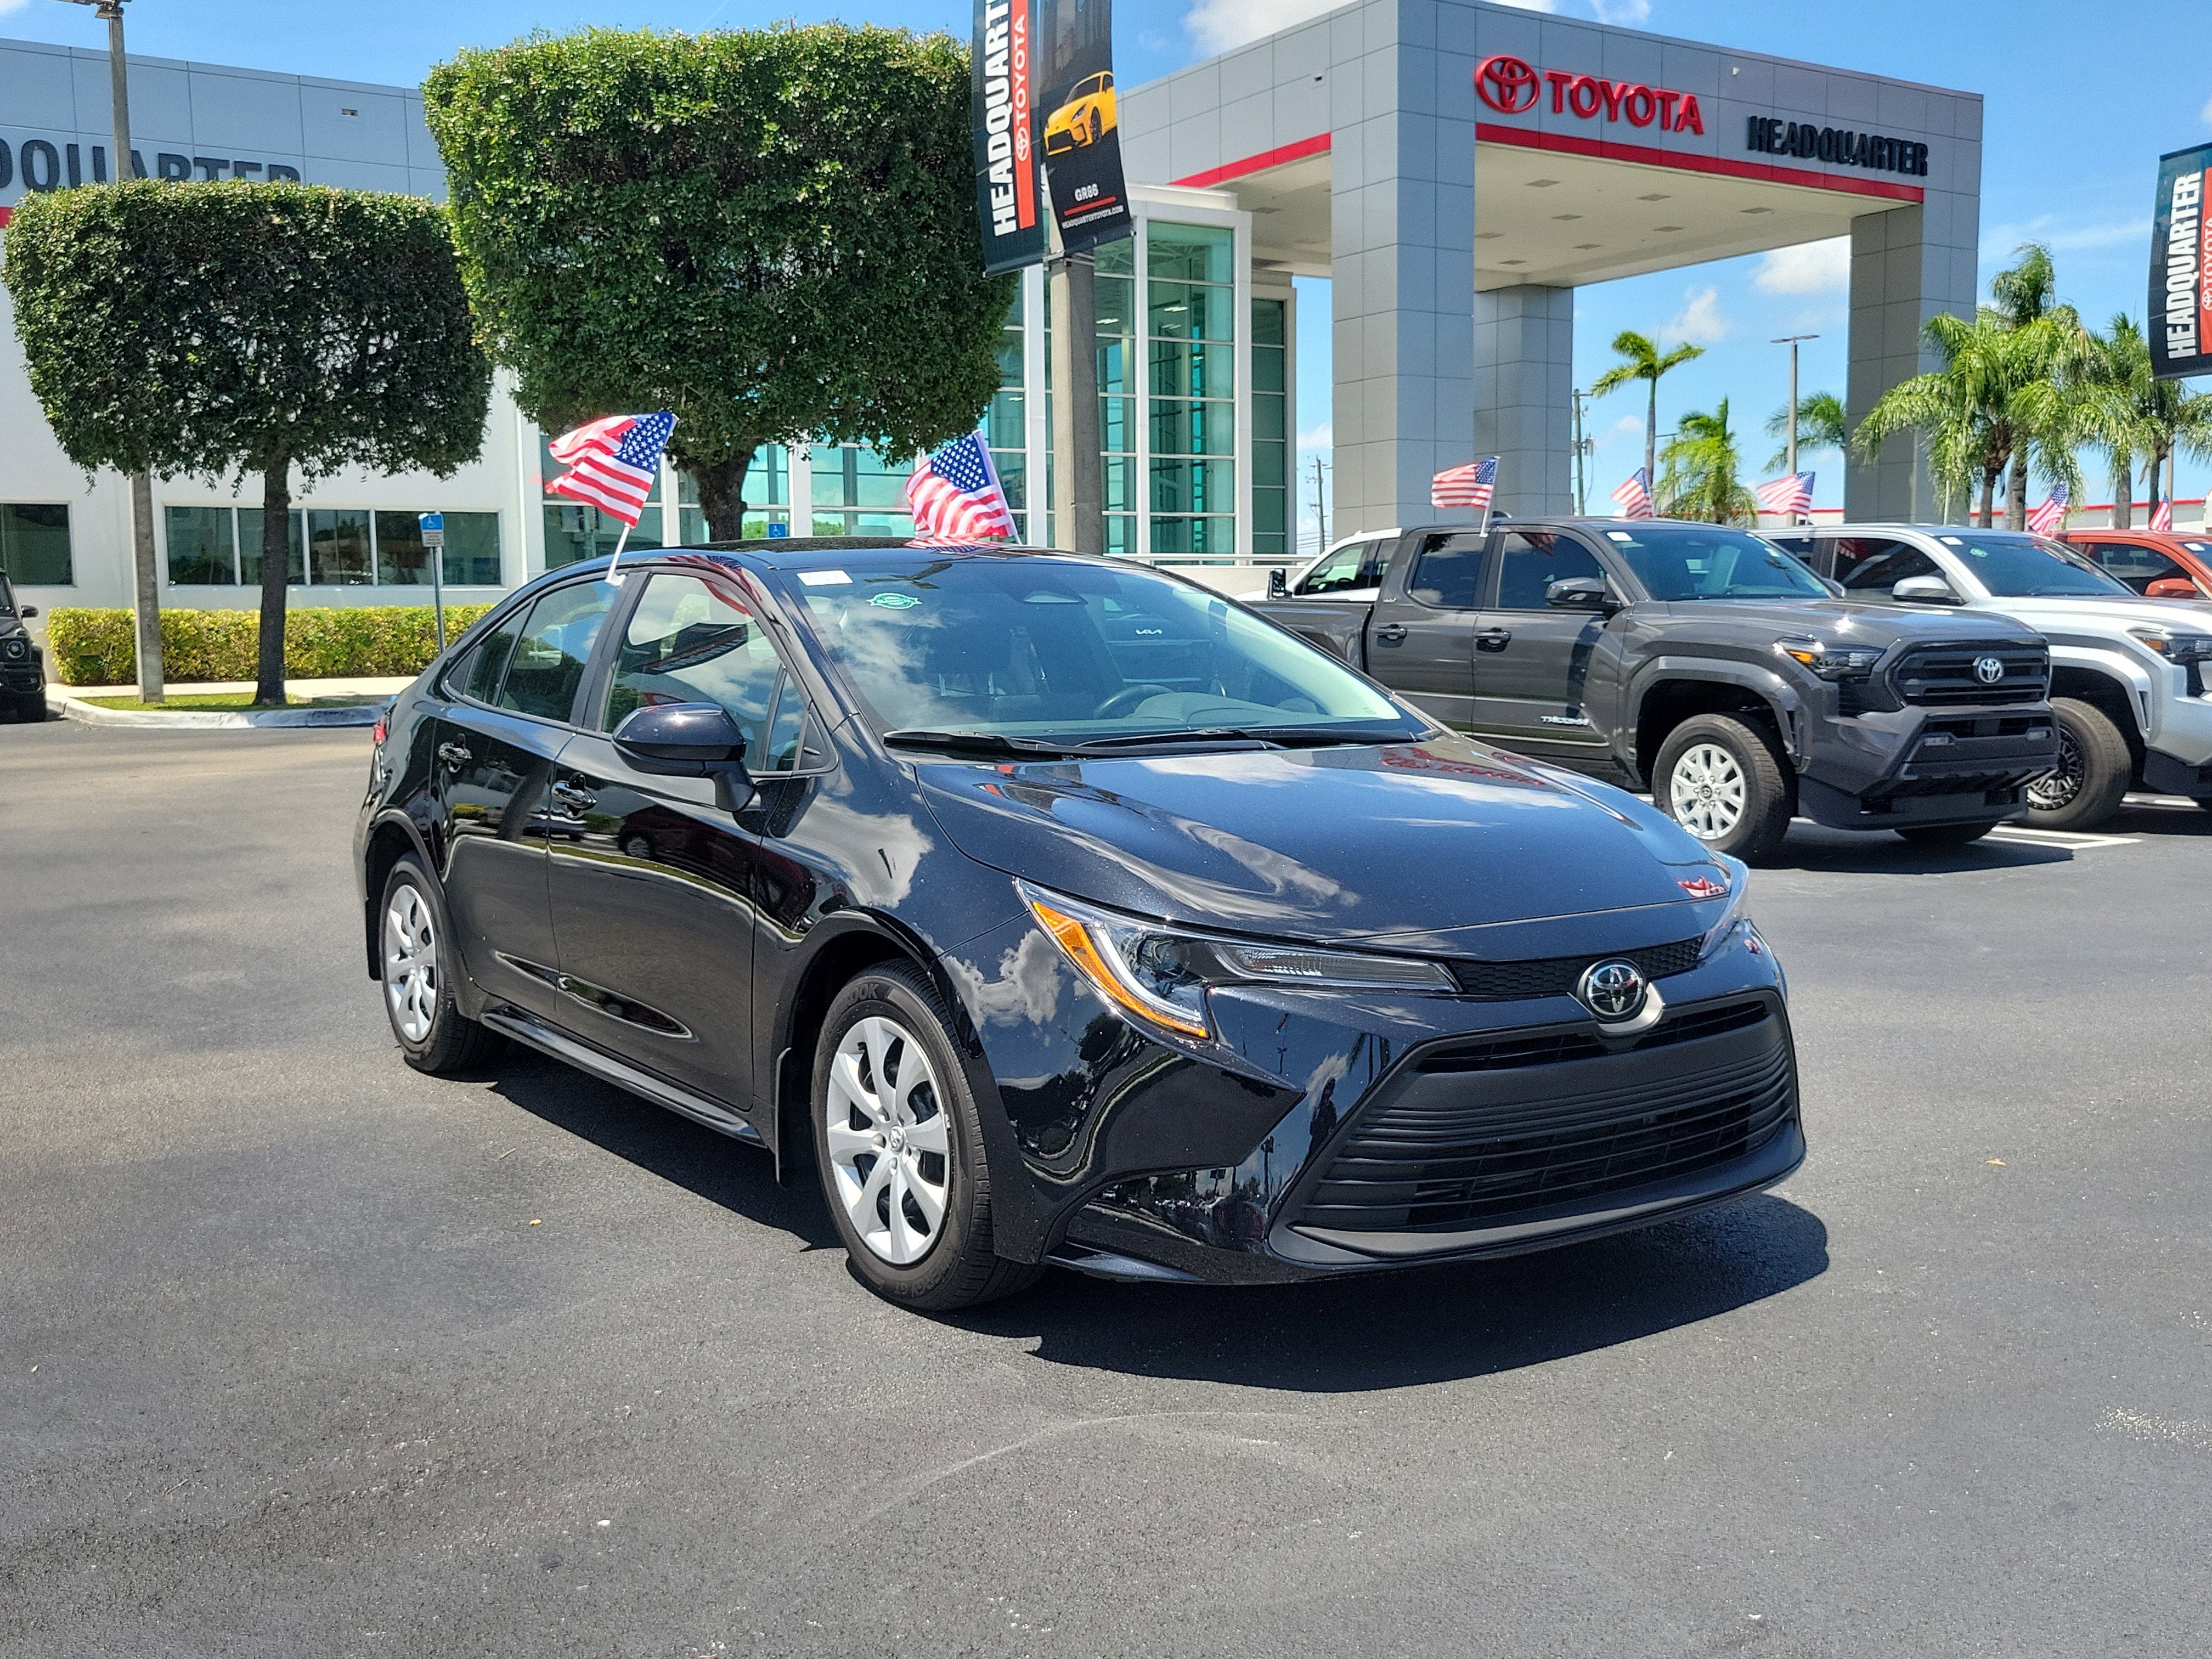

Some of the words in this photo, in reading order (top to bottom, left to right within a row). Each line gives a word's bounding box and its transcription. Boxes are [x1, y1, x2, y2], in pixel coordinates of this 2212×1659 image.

[1013, 14, 1030, 120] TOYOTA
[1544, 70, 1704, 135] TOYOTA
[985, 0, 1017, 236] HEADQUART
[1747, 115, 1928, 176] HEADQUARTER
[2165, 171, 2202, 359] HEADQUARTER
[2203, 217, 2212, 287] TOYOTA
